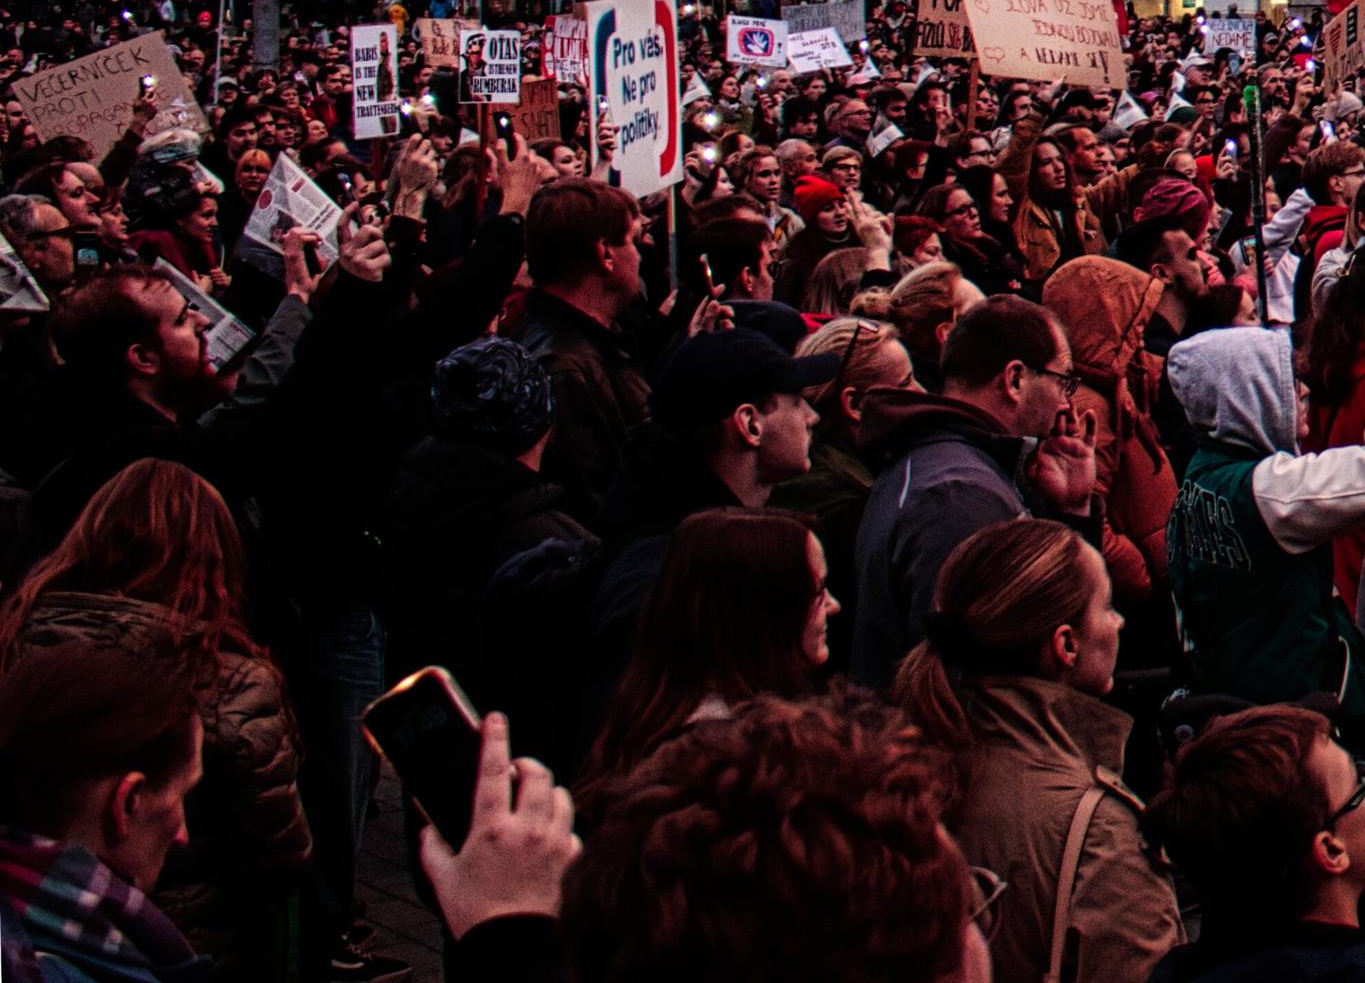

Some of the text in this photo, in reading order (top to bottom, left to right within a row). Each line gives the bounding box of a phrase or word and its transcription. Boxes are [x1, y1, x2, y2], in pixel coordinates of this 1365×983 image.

[613, 37, 635, 68] Pro
[640, 28, 663, 59] vás.
[1020, 48, 1030, 58] A
[364, 66, 376, 78] THE
[356, 84, 375, 101] NEW
[473, 78, 517, 93] RUMBURAK
[622, 71, 656, 105] Ne pro
[32, 88, 101, 125] PROTI
[621, 106, 661, 154] politiky.
